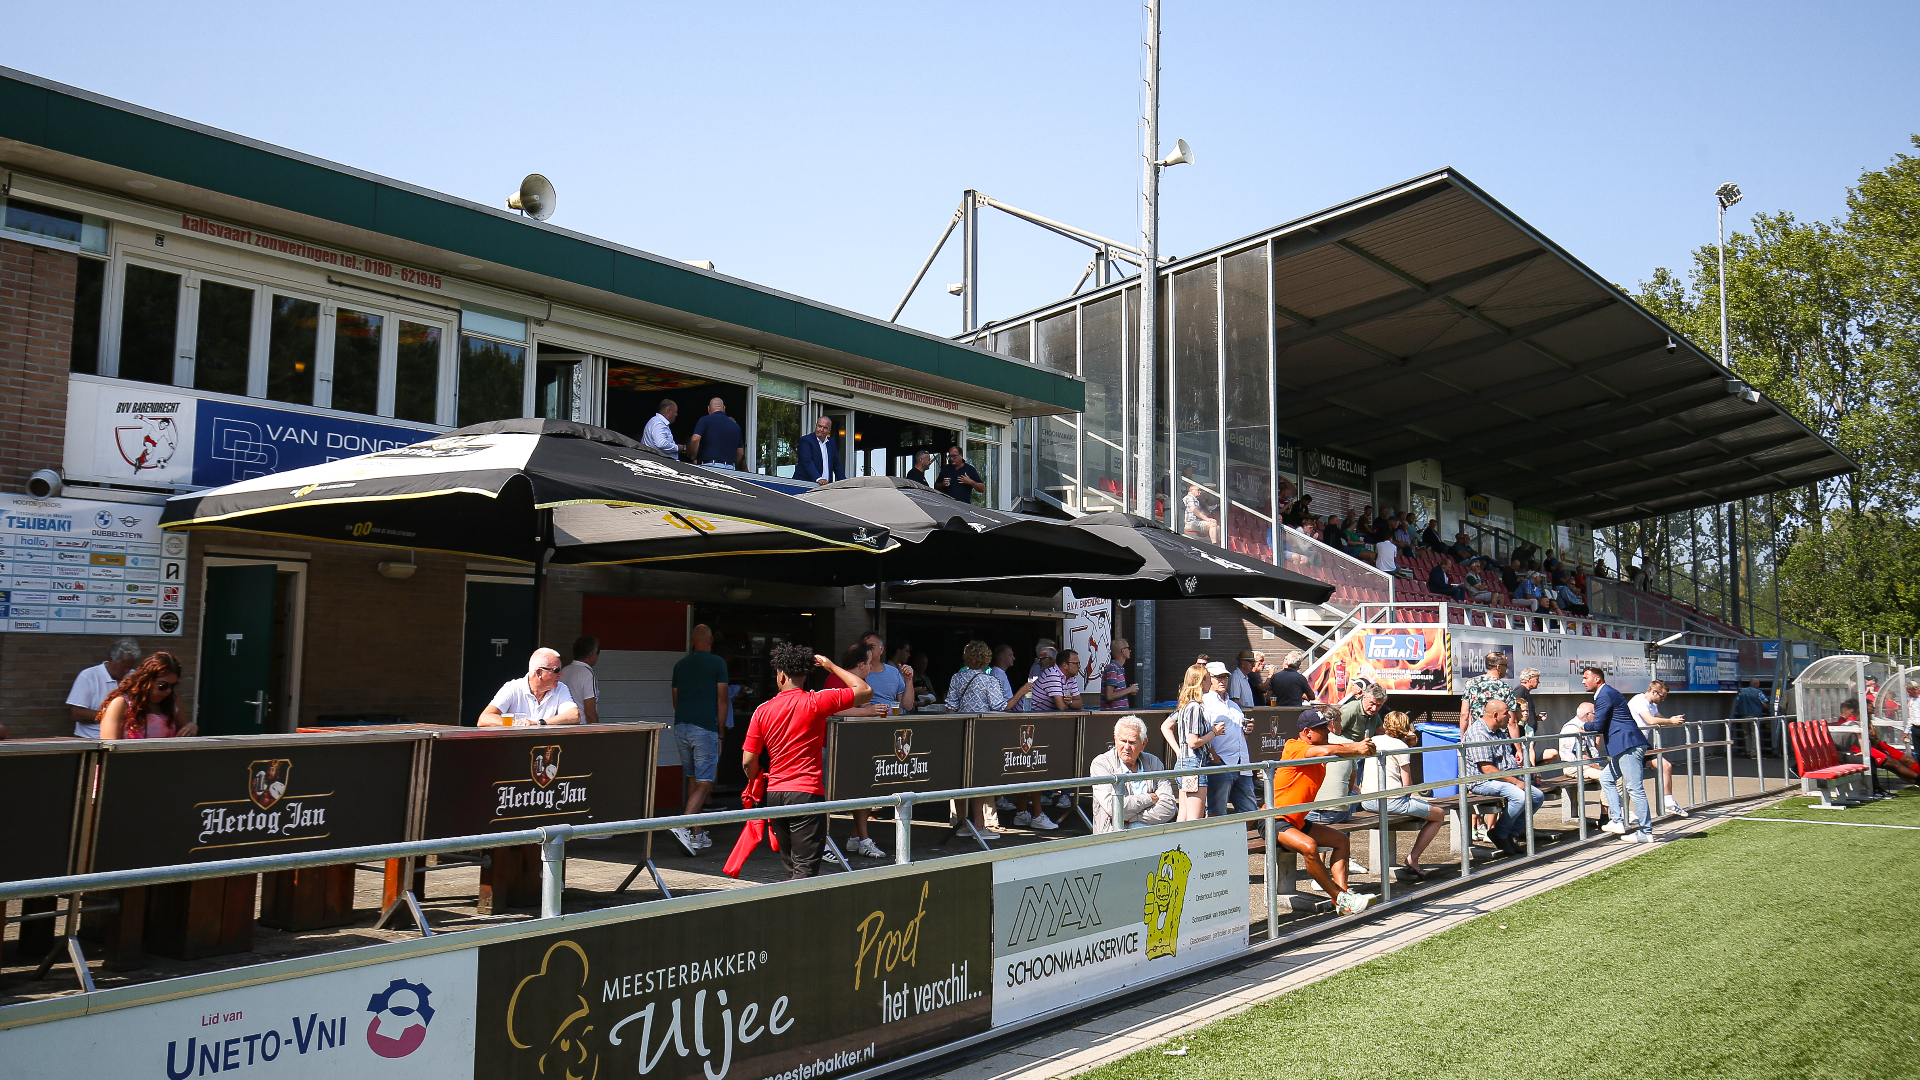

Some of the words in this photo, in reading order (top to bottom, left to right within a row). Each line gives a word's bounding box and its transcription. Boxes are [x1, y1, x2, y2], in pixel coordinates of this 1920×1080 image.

[182, 213, 252, 244] kalisvaart
[254, 233, 337, 266] zonweringen
[364, 259, 392, 278] 0180
[401, 267, 442, 290] 621945
[859, 379, 871, 391] alle
[132, 402, 181, 414] BARENDRECHT
[266, 424, 318, 446] VAN
[1337, 458, 1367, 477] RECLAME
[1471, 500, 1487, 512] IKEA
[6, 516, 72, 532] TSUBAKI
[92, 530, 143, 539] DUBBELSTEYN
[52, 581, 72, 590] ING
[874, 759, 910, 782] Hertog
[909, 756, 929, 779] Jan
[1003, 751, 1031, 771] Hertog
[1031, 749, 1047, 769] Jan
[495, 786, 555, 816] Hertog
[555, 781, 587, 811] Jan
[198, 807, 282, 844] Hertog
[281, 801, 326, 836] Jan
[1007, 872, 1102, 947] MAX
[854, 880, 929, 990] Proef
[1006, 931, 1139, 988] SCHOONMAAKSERVICE
[882, 980, 910, 1024] het
[913, 959, 983, 1015] verschil...
[202, 1012, 219, 1027] Lid
[223, 1011, 243, 1024] van
[609, 989, 795, 1080] Uljee
